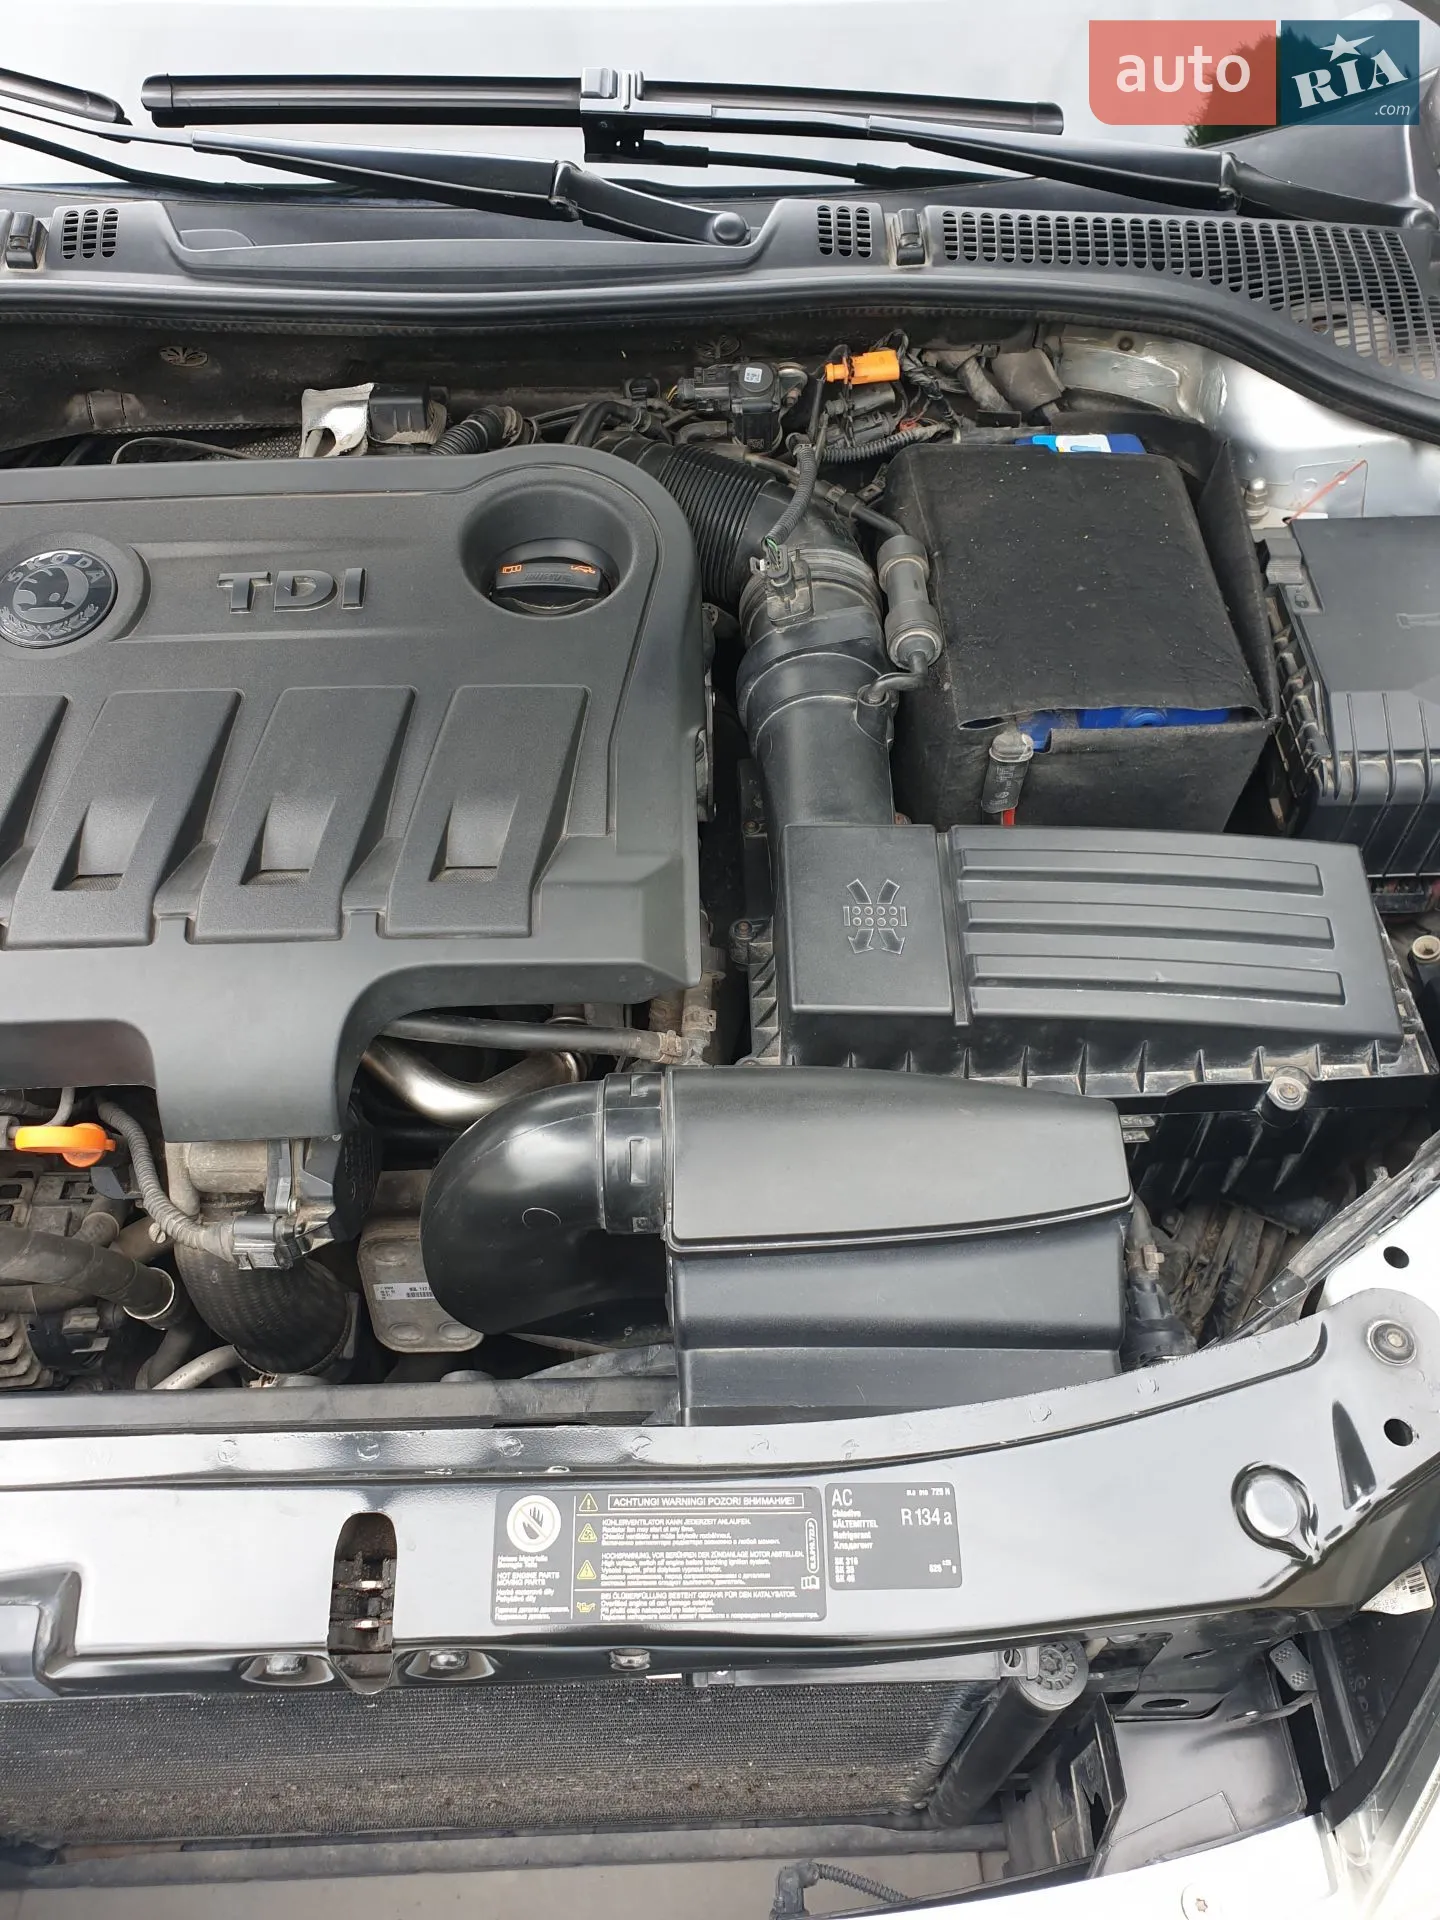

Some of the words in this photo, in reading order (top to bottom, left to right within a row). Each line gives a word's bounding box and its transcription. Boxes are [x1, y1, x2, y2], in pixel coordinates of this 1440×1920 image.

[217, 568, 367, 614] TDI
[613, 1497, 660, 1507] ACHTUNG!
[661, 1497, 706, 1506] WARNING!
[707, 1497, 742, 1506] POZOR!
[743, 1496, 796, 1506] ВНИМАНИЕ!
[832, 1489, 853, 1506] AC
[901, 1508, 913, 1525] R
[914, 1508, 941, 1526] 134
[943, 1511, 953, 1526] a
